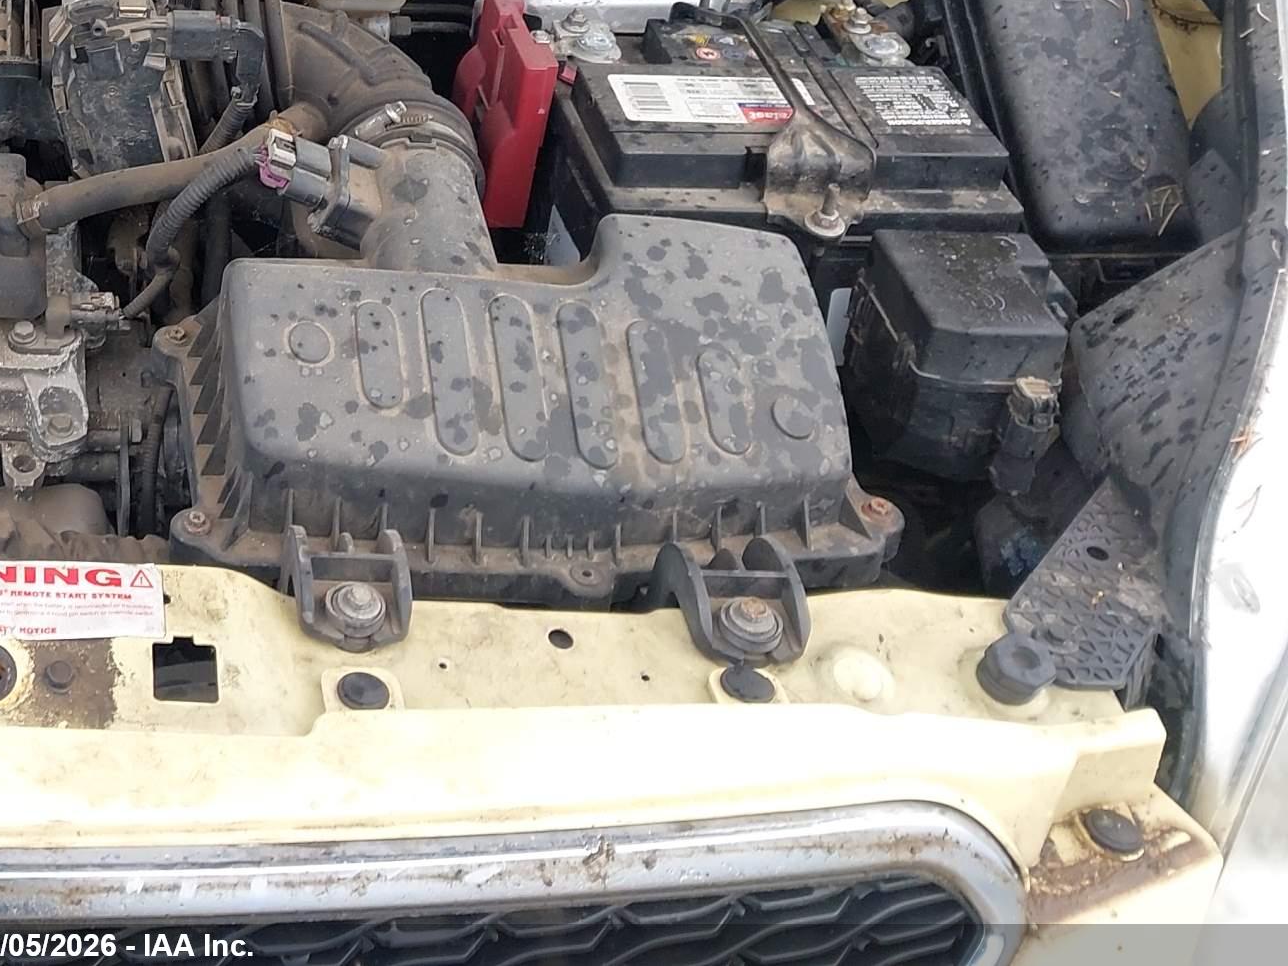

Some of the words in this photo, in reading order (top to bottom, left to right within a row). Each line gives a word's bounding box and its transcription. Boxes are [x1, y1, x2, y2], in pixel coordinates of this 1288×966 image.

[10, 590, 52, 598] REMOTE
[91, 592, 132, 600] SYSTEM
[19, 626, 57, 635] NOTICE
